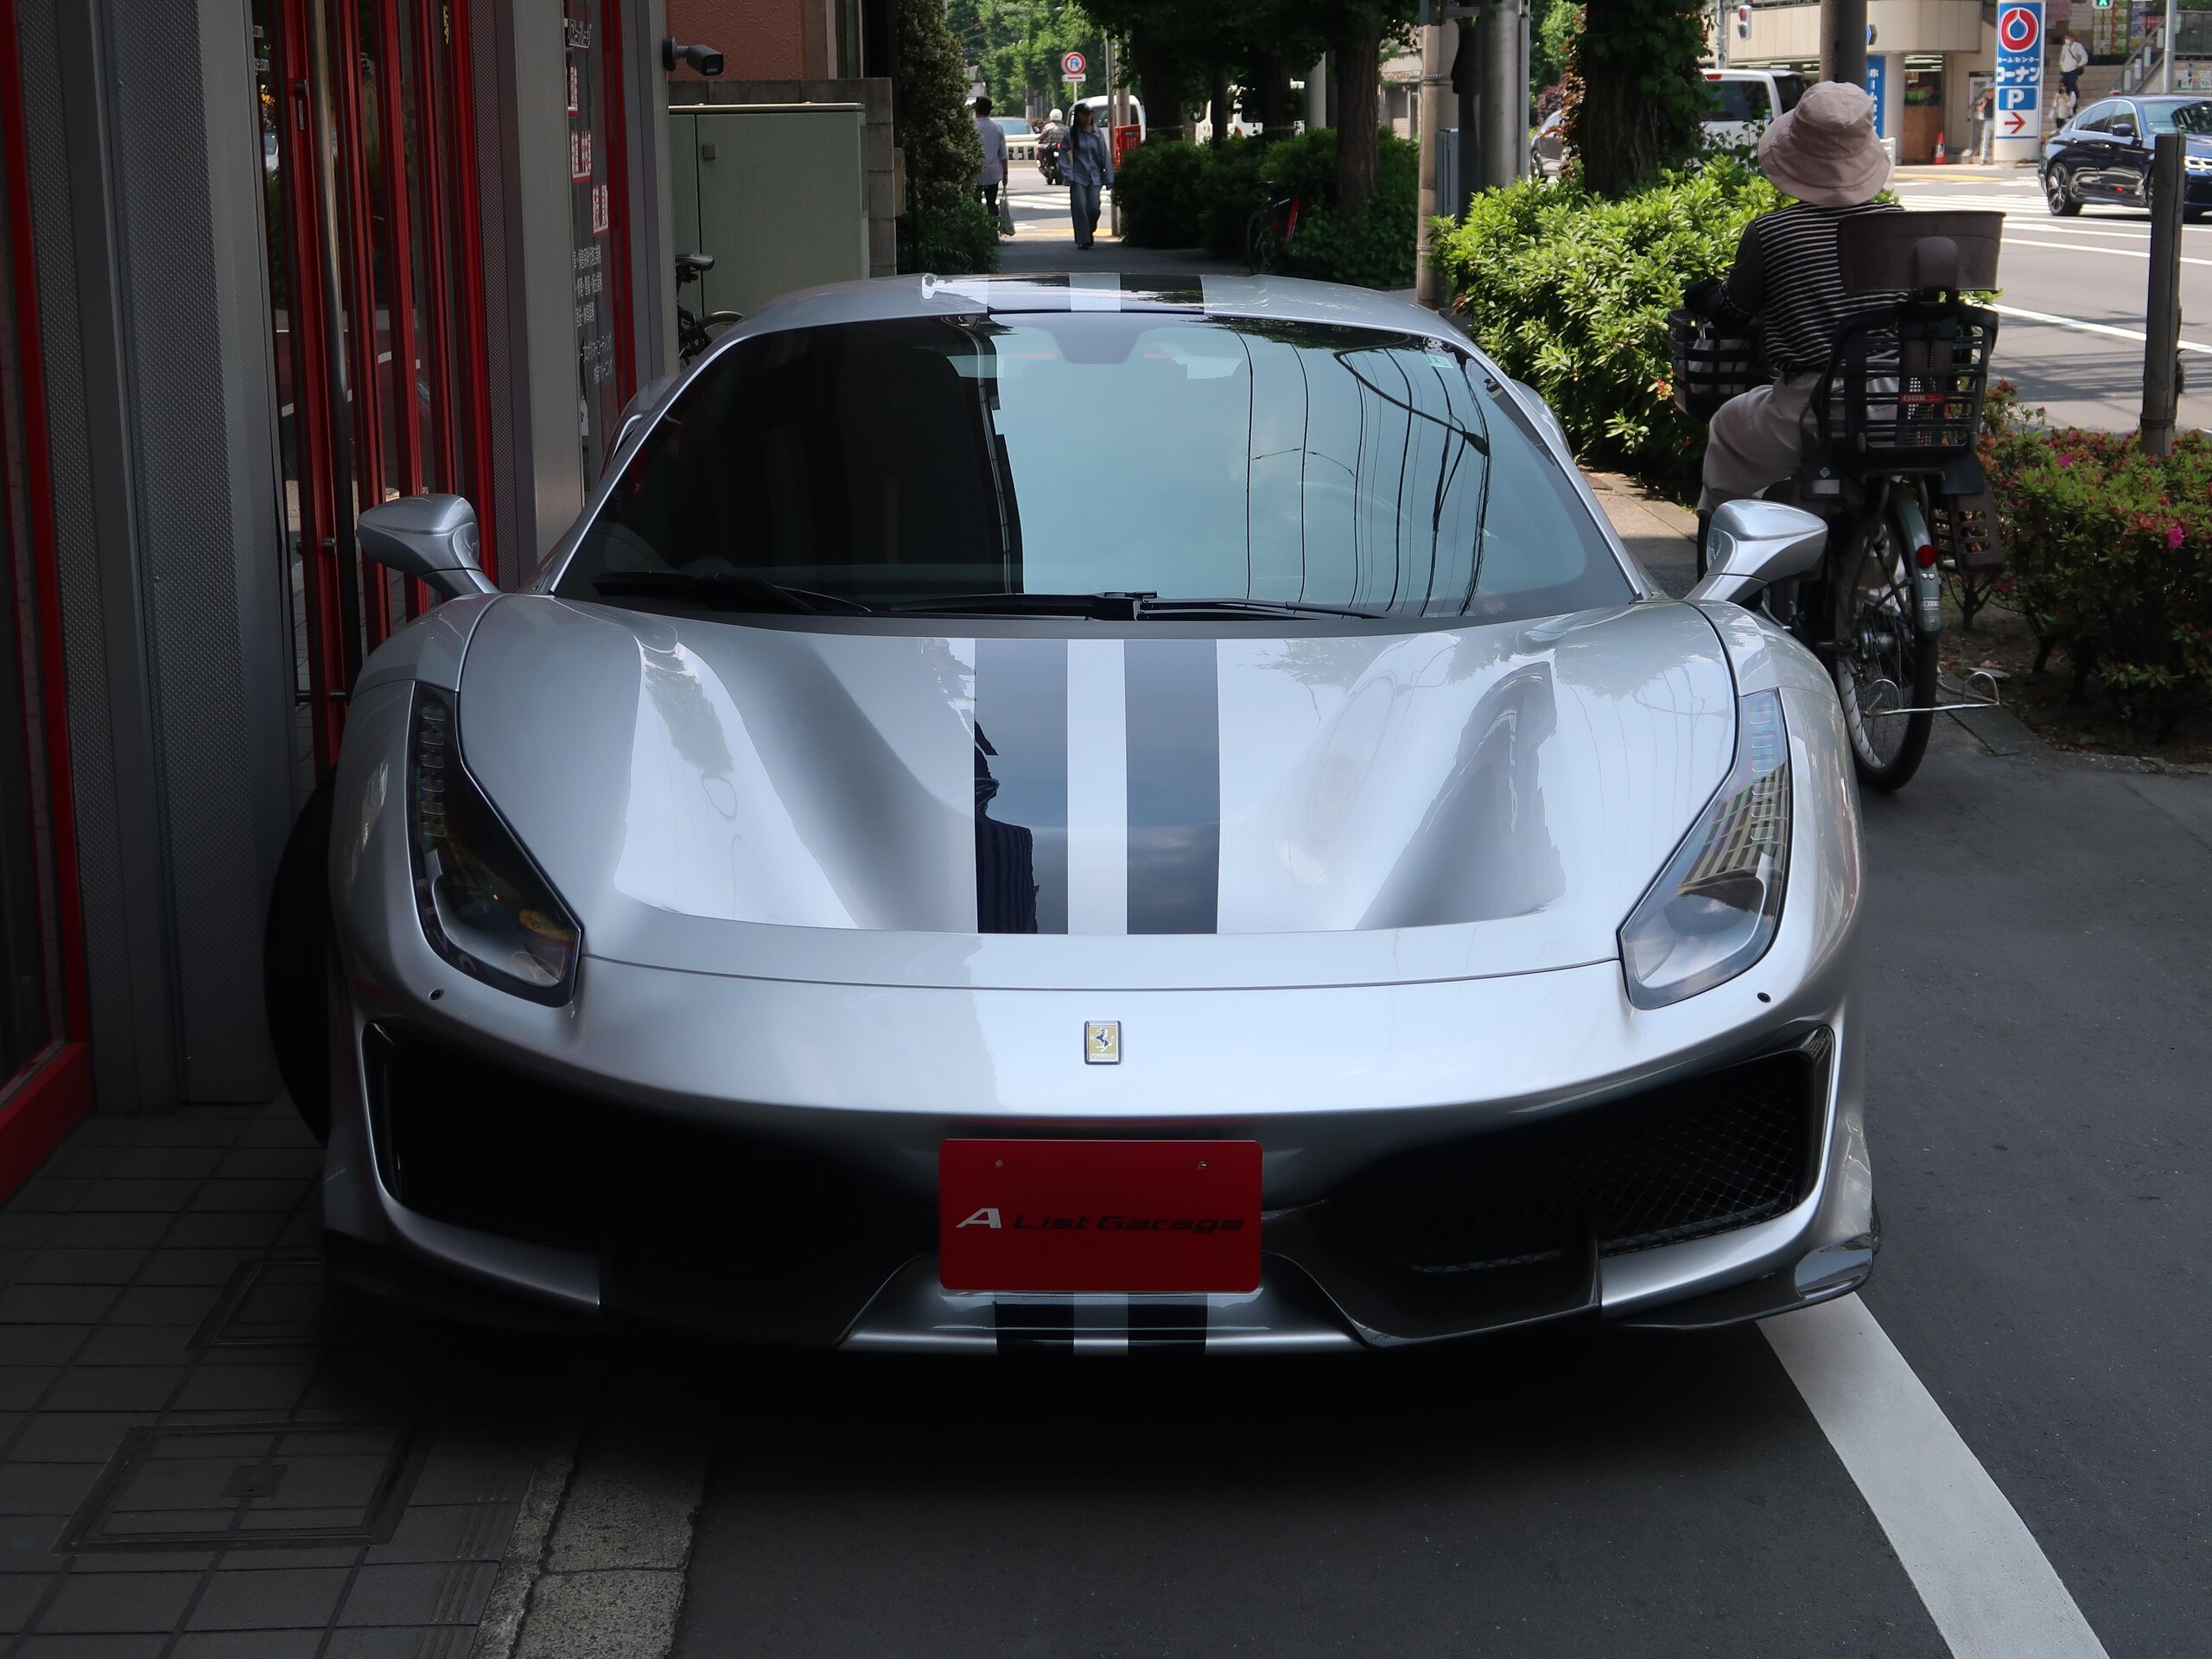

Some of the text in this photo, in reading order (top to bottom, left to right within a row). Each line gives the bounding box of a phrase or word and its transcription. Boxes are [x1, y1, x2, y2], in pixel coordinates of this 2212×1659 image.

[1997, 66, 2041, 83] コーナン
[2007, 89, 2024, 109] P
[955, 1207, 1245, 1233] A List Garage
